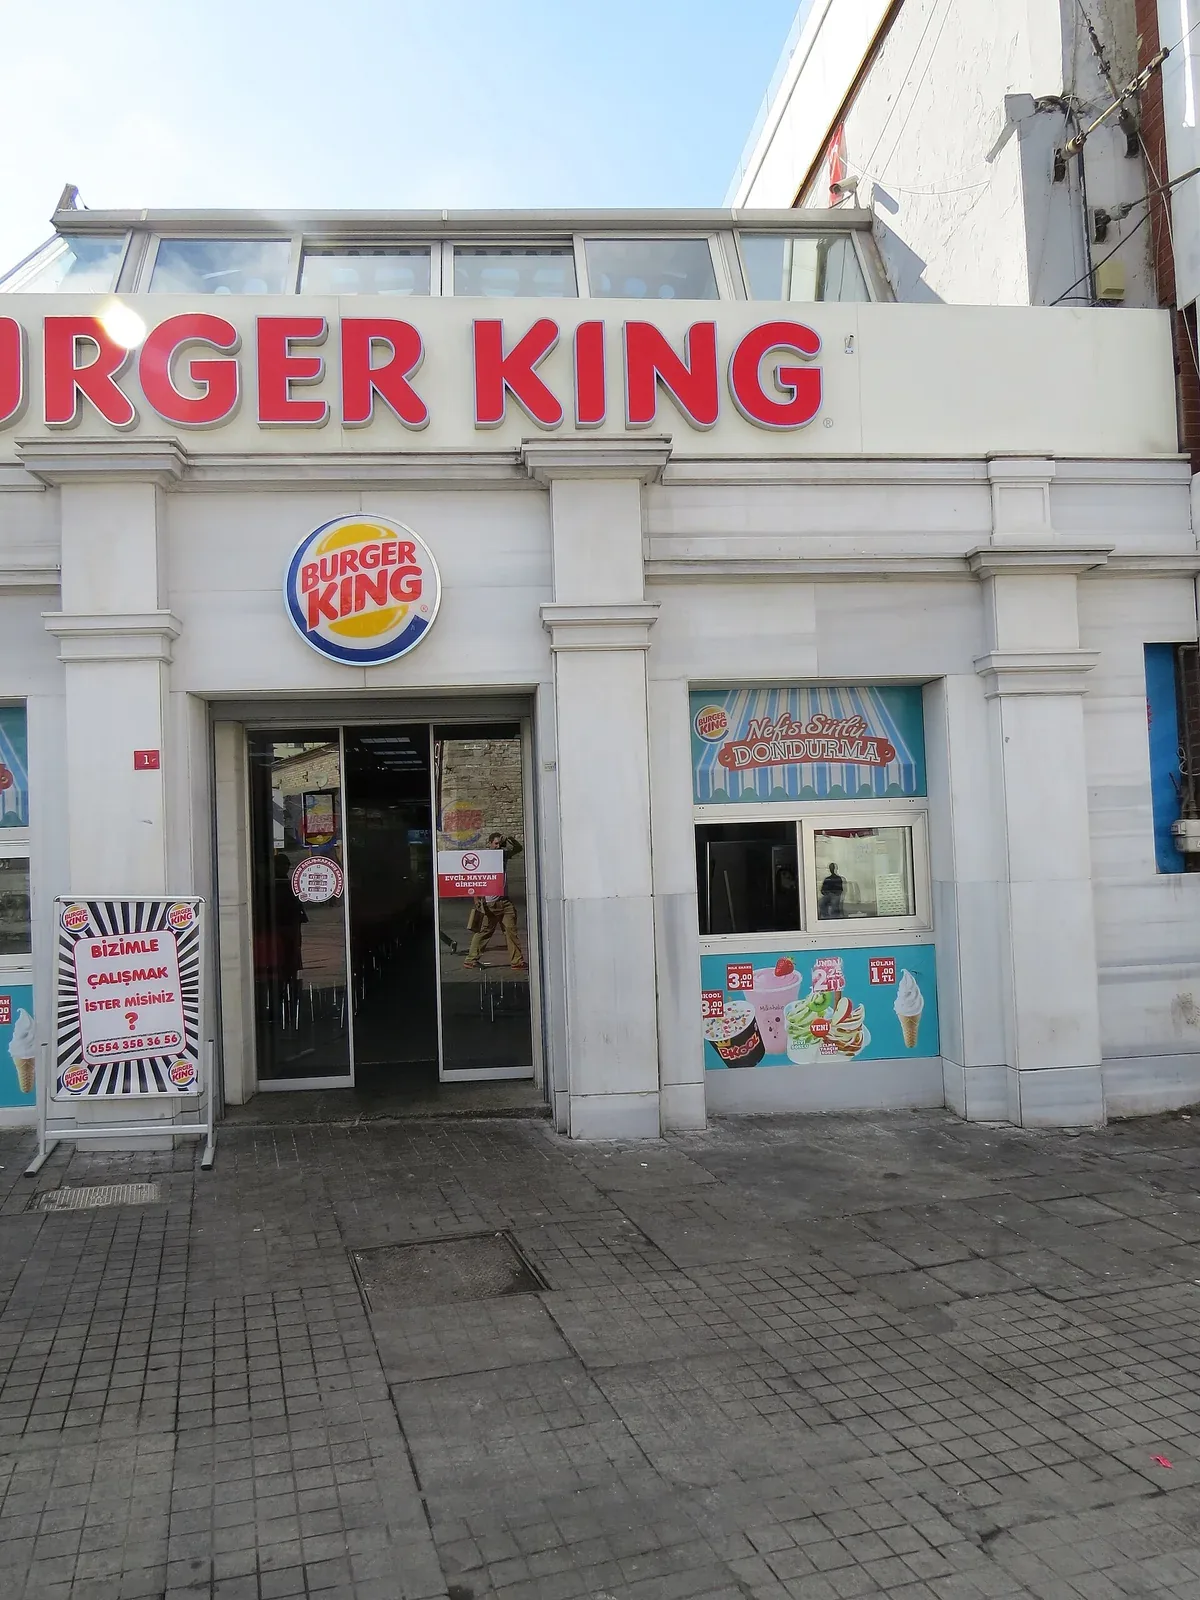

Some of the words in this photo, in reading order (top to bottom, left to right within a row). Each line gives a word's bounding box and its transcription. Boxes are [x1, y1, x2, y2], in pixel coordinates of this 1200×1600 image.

[472, 317, 823, 432] KING
[302, 541, 417, 594] BURGER
[308, 565, 423, 630] KING
[698, 711, 726, 726] BURGER
[699, 719, 728, 736] KING
[746, 713, 801, 742] Nefis
[805, 713, 867, 739] Sütlü
[732, 738, 881, 767] DONDURMA
[444, 874, 466, 882] EVCİL
[64, 908, 88, 920] BURGER
[169, 907, 192, 919] BURGER
[170, 913, 193, 926] KING
[65, 914, 89, 927] KING
[91, 938, 159, 958] BİZİMLE
[87, 966, 169, 990] ÇALIŞMAK
[740, 980, 753, 988] TL
[881, 974, 894, 982] TL
[84, 998, 121, 1013] İSTER
[124, 989, 175, 1008] MİSİNİZ
[710, 1007, 723, 1015] TL
[124, 1011, 139, 1031] ?
[810, 1022, 829, 1032] YENİ
[90, 1041, 119, 1054] 0554
[122, 1038, 144, 1050] 358
[147, 1036, 160, 1047] 36
[164, 1034, 178, 1044] 56
[64, 1069, 88, 1081] BURGER
[170, 1063, 193, 1075] BURGER
[172, 1068, 194, 1082] KING
[65, 1074, 89, 1087] KING
